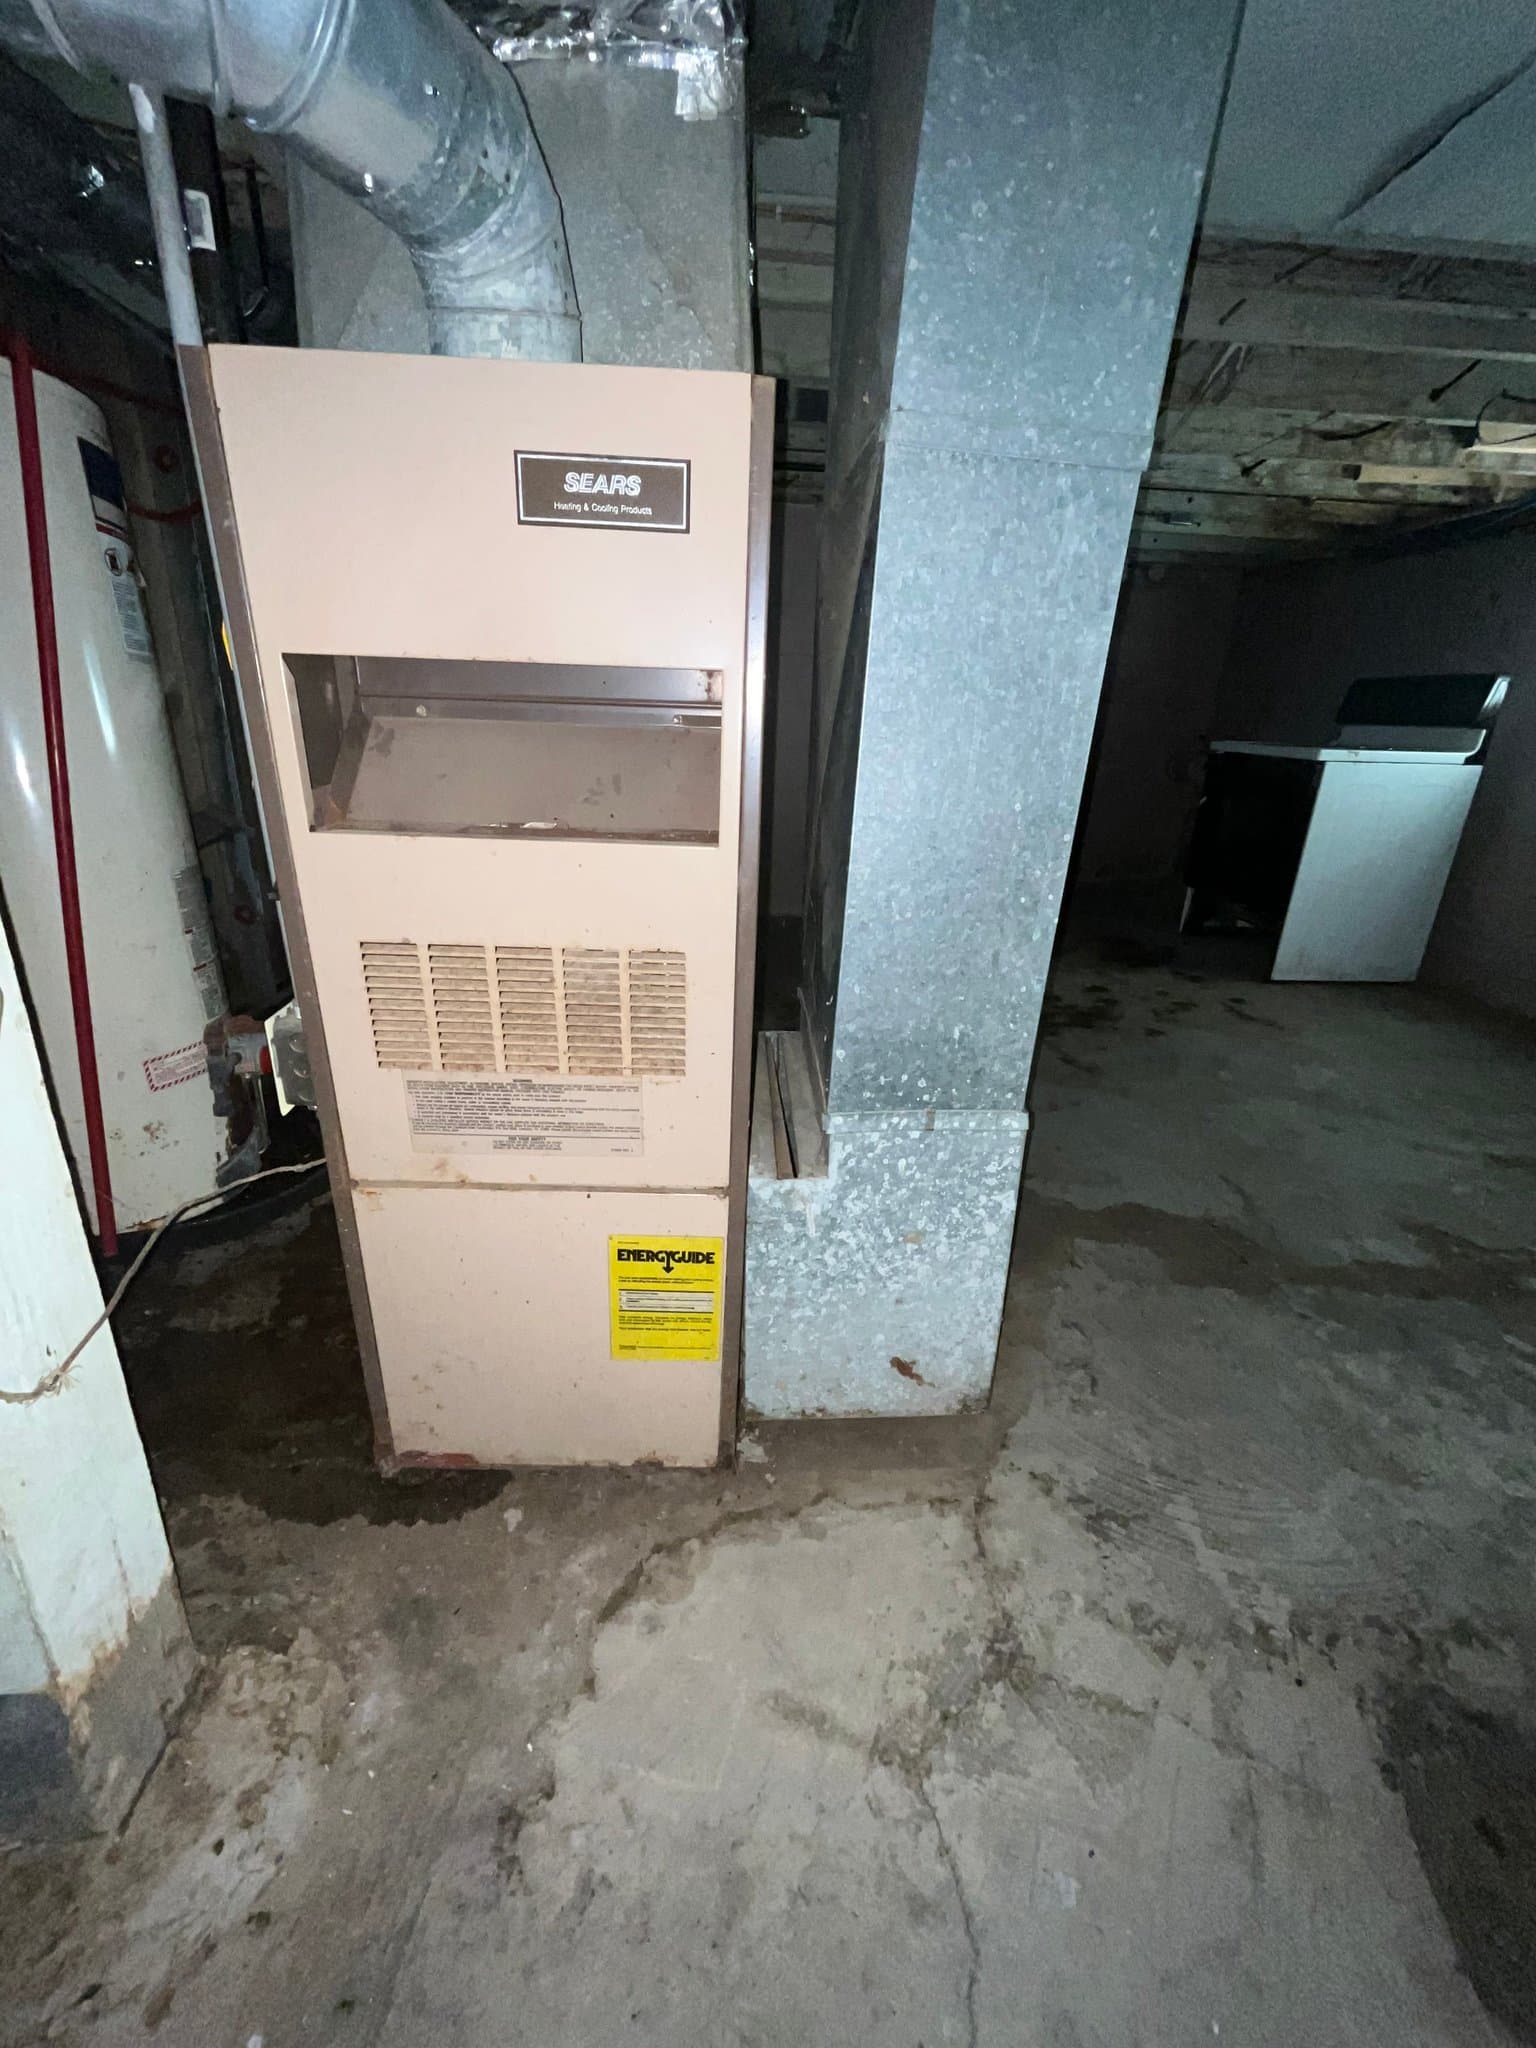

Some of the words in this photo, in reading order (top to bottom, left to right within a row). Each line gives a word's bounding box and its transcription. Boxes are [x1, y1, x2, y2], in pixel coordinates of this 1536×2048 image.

[563, 471, 642, 497] SEARS
[553, 501, 582, 513] Heating
[583, 502, 590, 511] &
[591, 503, 619, 515] Cooling
[620, 504, 653, 515] Products
[617, 1248, 716, 1265] ENERGYGUIDE
